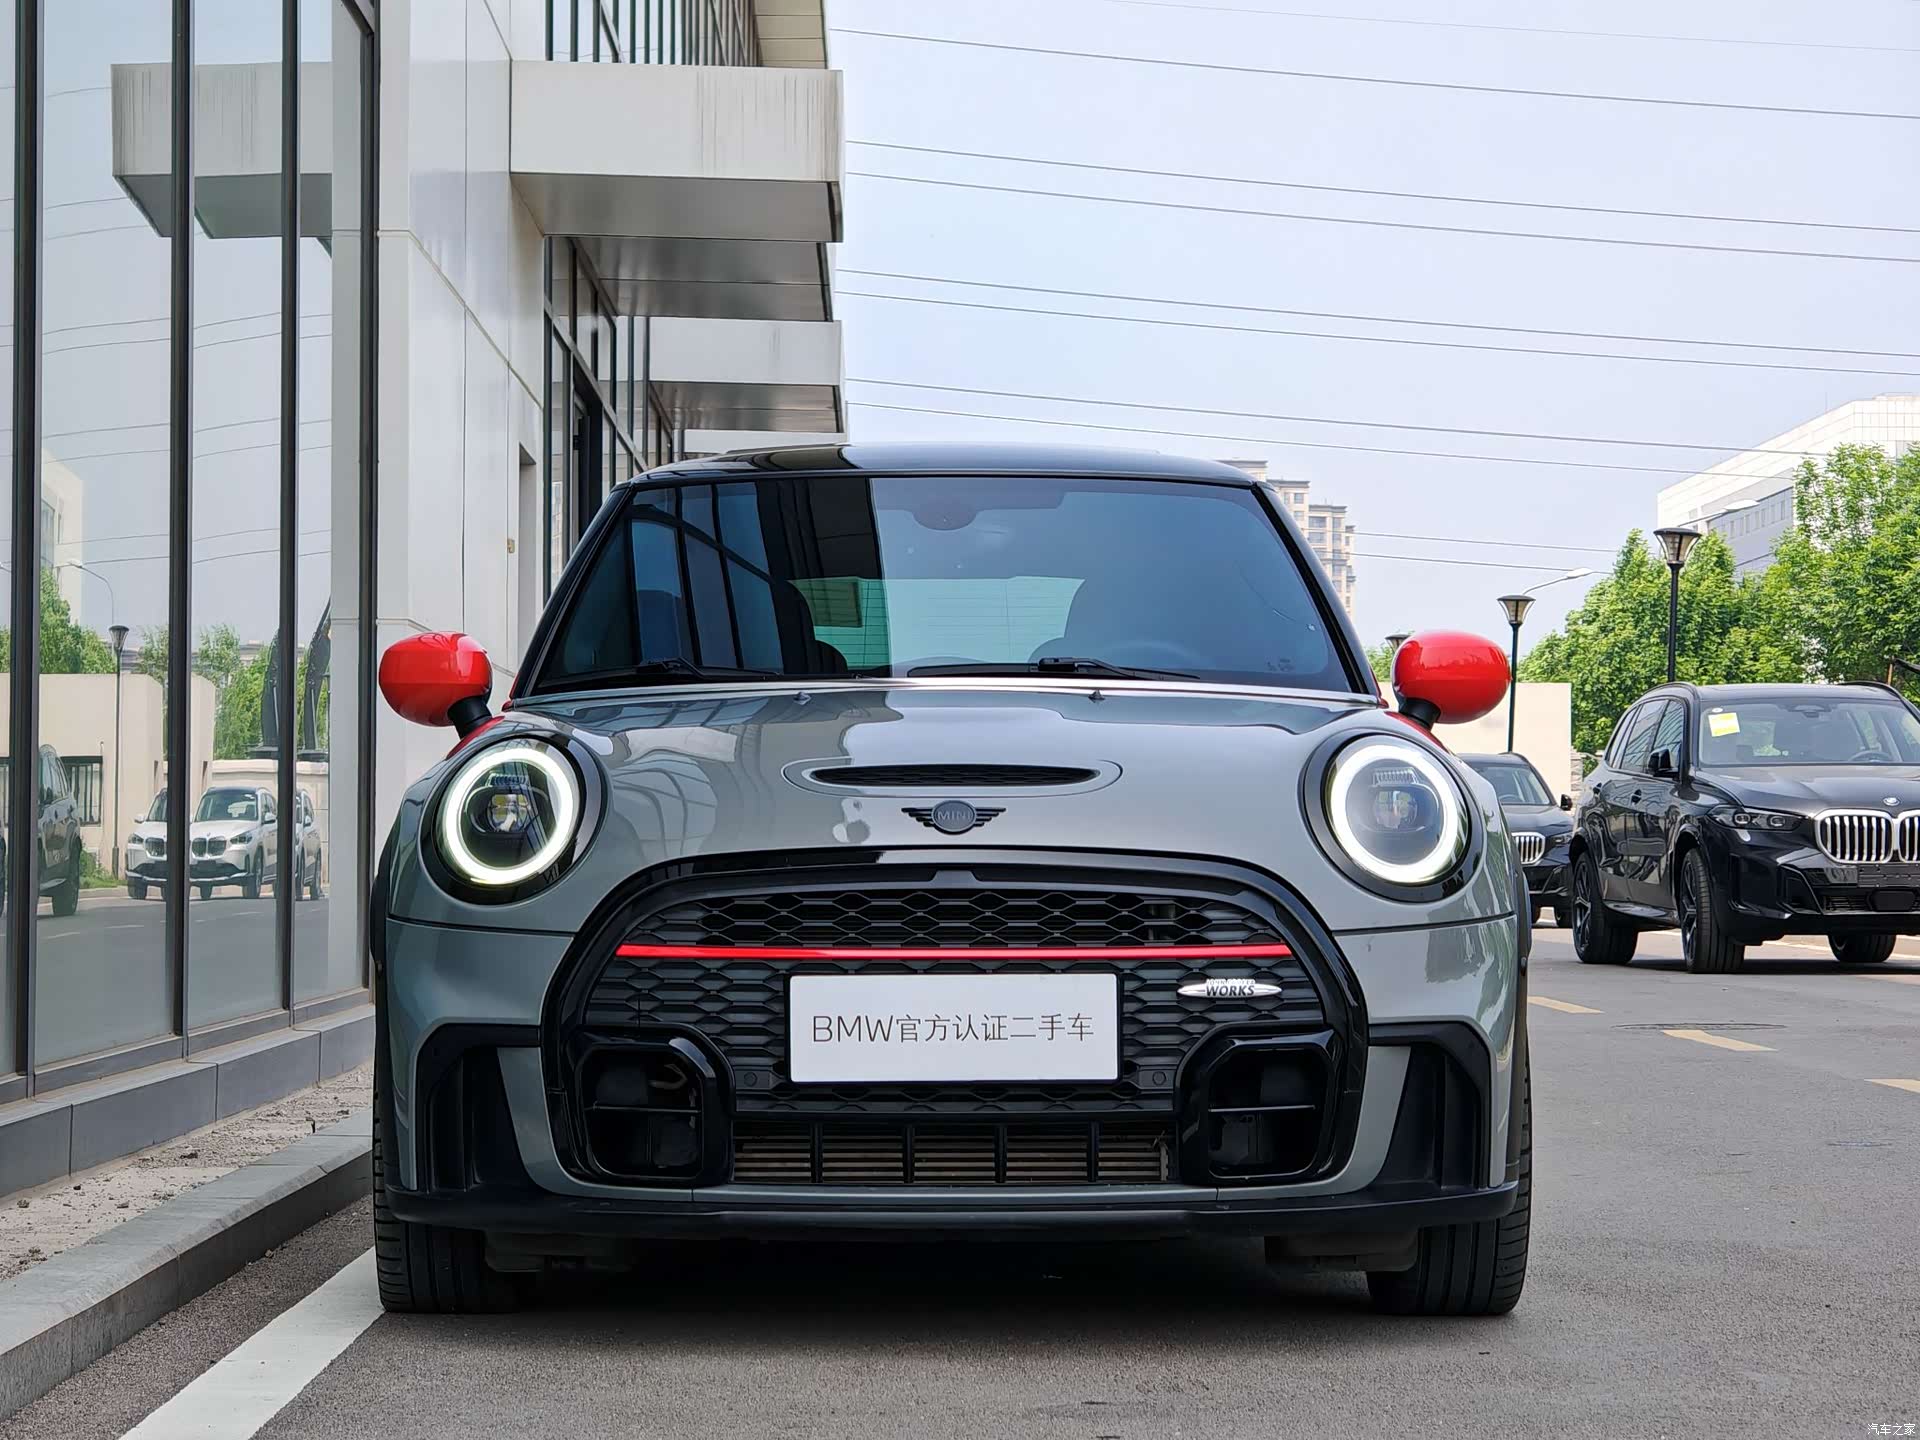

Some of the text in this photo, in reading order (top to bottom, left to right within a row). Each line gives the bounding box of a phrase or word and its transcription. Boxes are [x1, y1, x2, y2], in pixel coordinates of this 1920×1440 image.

[937, 810, 972, 821] MINI
[1206, 985, 1255, 997] WORKS
[811, 1013, 1094, 1042] BMW官方认证二手车
